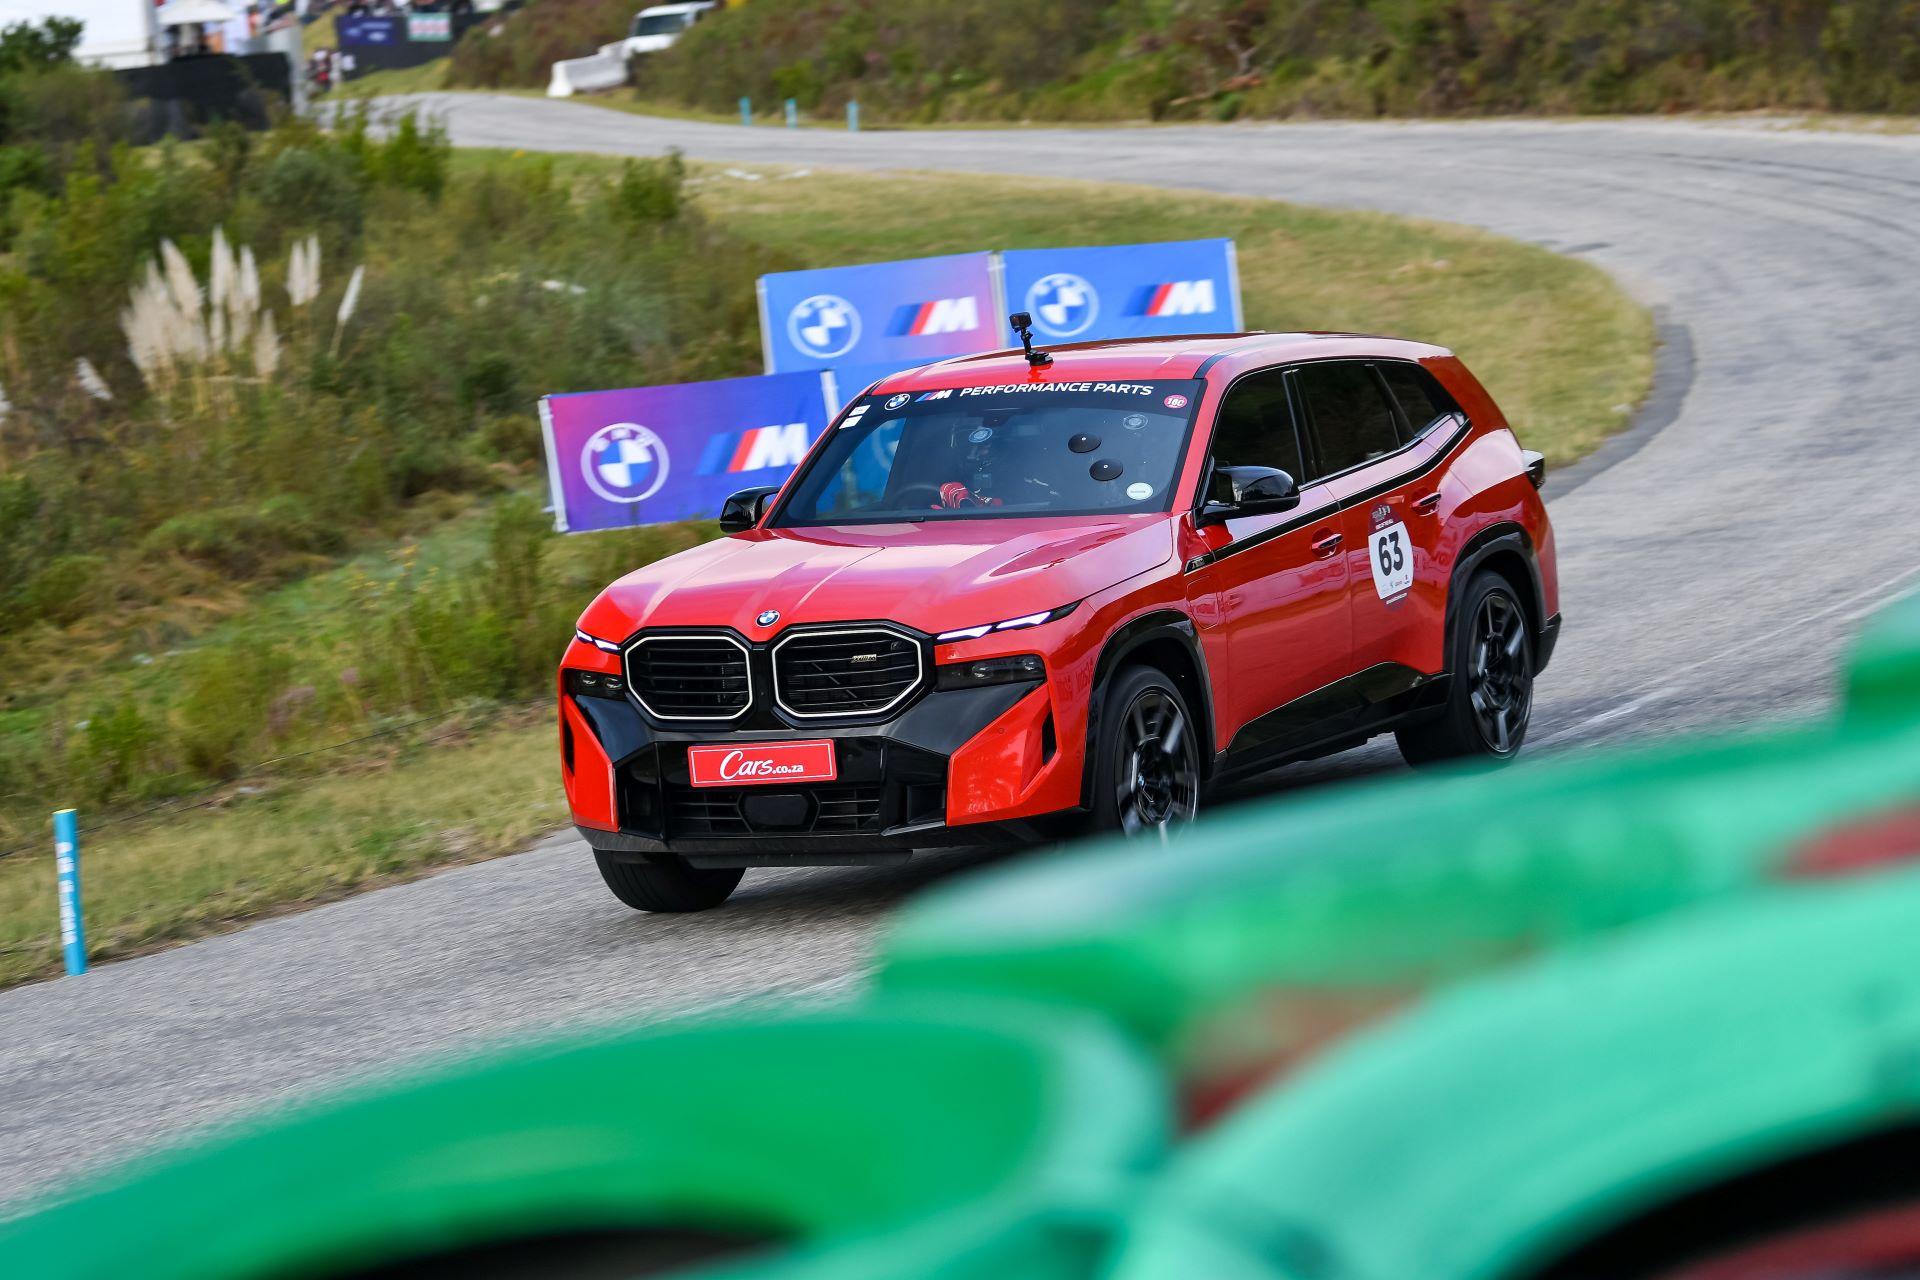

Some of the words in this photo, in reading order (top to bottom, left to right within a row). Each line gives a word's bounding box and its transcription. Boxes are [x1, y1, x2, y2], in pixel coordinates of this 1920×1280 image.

[959, 382, 1093, 397] PERFORMANCE
[1093, 382, 1155, 396] PARTS
[1378, 531, 1404, 577] 63
[719, 750, 804, 780] Cars.co.za
